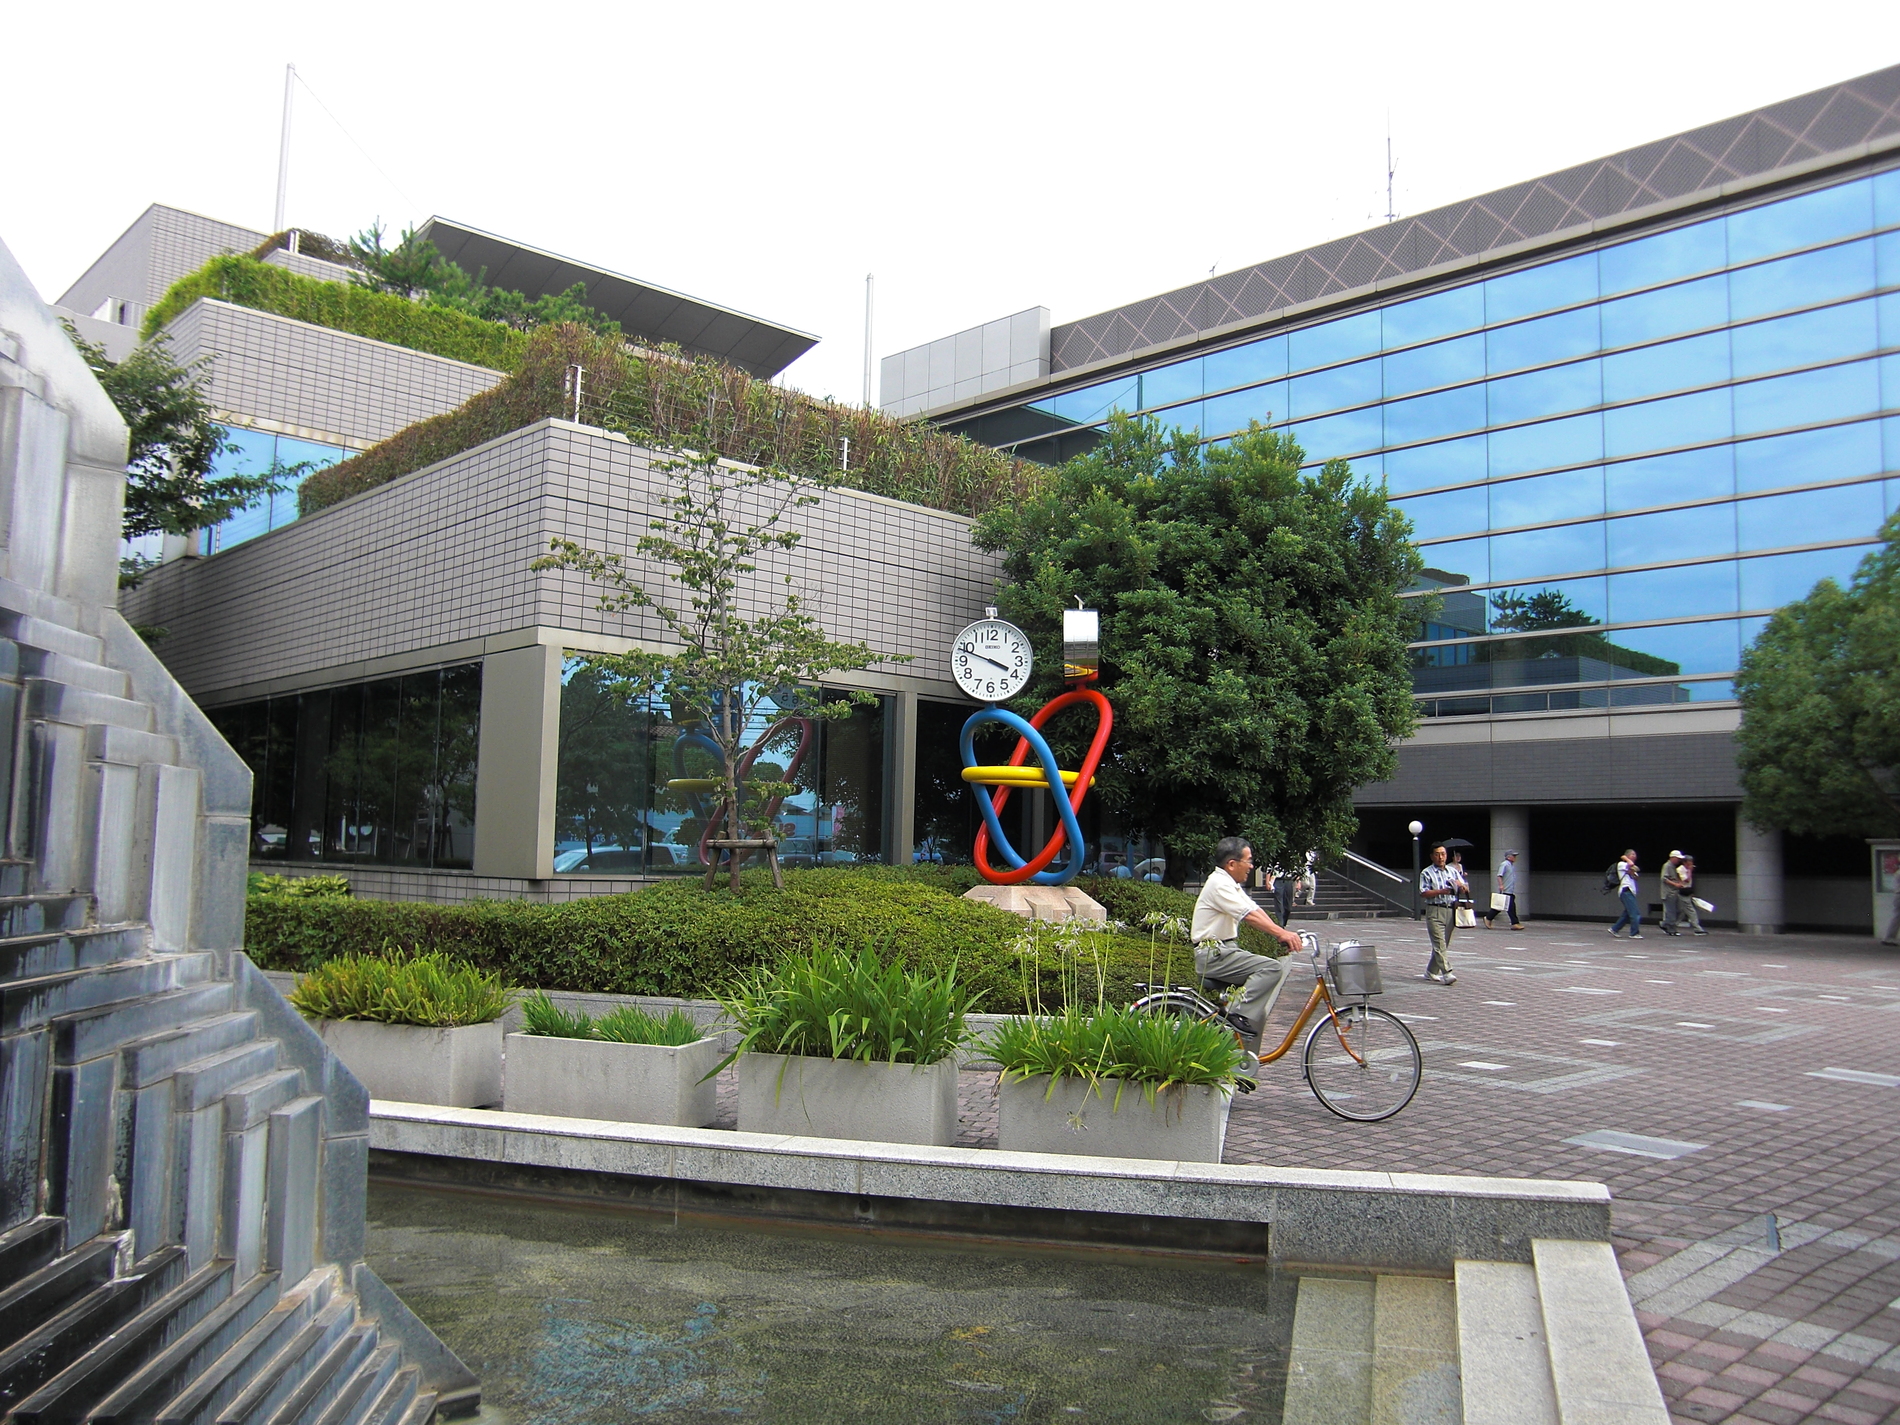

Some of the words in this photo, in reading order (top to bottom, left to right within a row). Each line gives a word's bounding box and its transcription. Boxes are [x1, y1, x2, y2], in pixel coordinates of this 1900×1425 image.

[975, 632, 984, 643] 11
[987, 629, 998, 640] 12
[962, 642, 974, 653] 10
[1011, 642, 1020, 653] 2
[958, 656, 968, 666] 9
[1014, 656, 1024, 667] 3
[964, 668, 972, 679] 8
[1010, 669, 1019, 680] 4
[974, 679, 982, 690] 7
[986, 682, 995, 694] 6
[1000, 679, 1008, 690] 5
